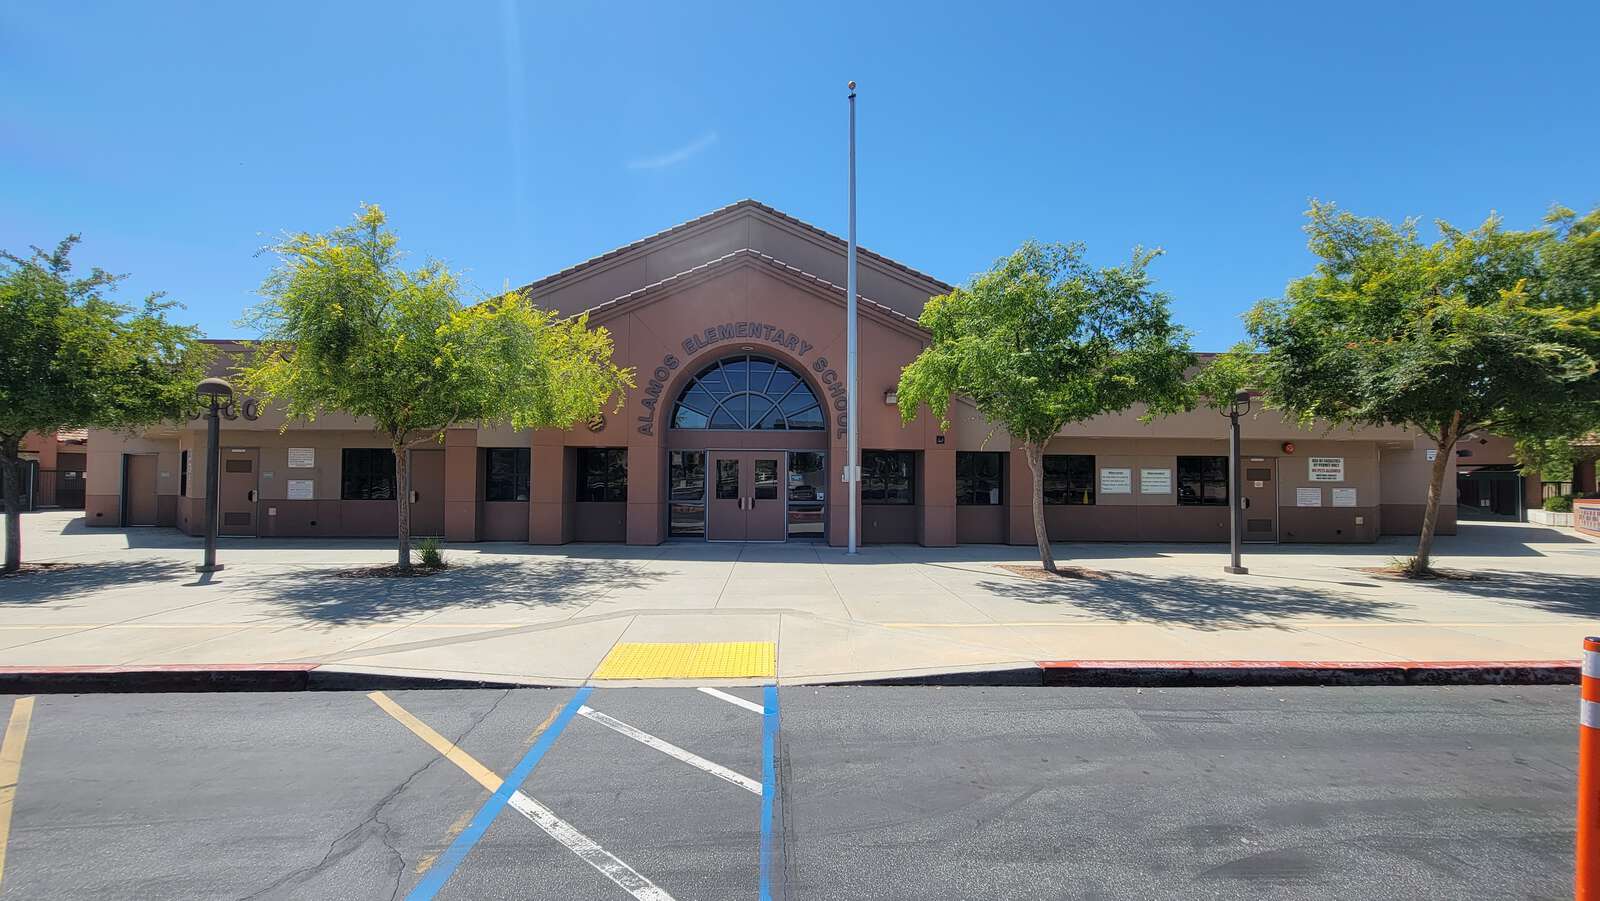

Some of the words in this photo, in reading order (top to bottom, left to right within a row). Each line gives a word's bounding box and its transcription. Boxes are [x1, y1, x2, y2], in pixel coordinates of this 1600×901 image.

[638, 353, 680, 436] ALAMOS
[681, 322, 813, 356] ELEMENTARY
[812, 356, 848, 440] SCHOOL
